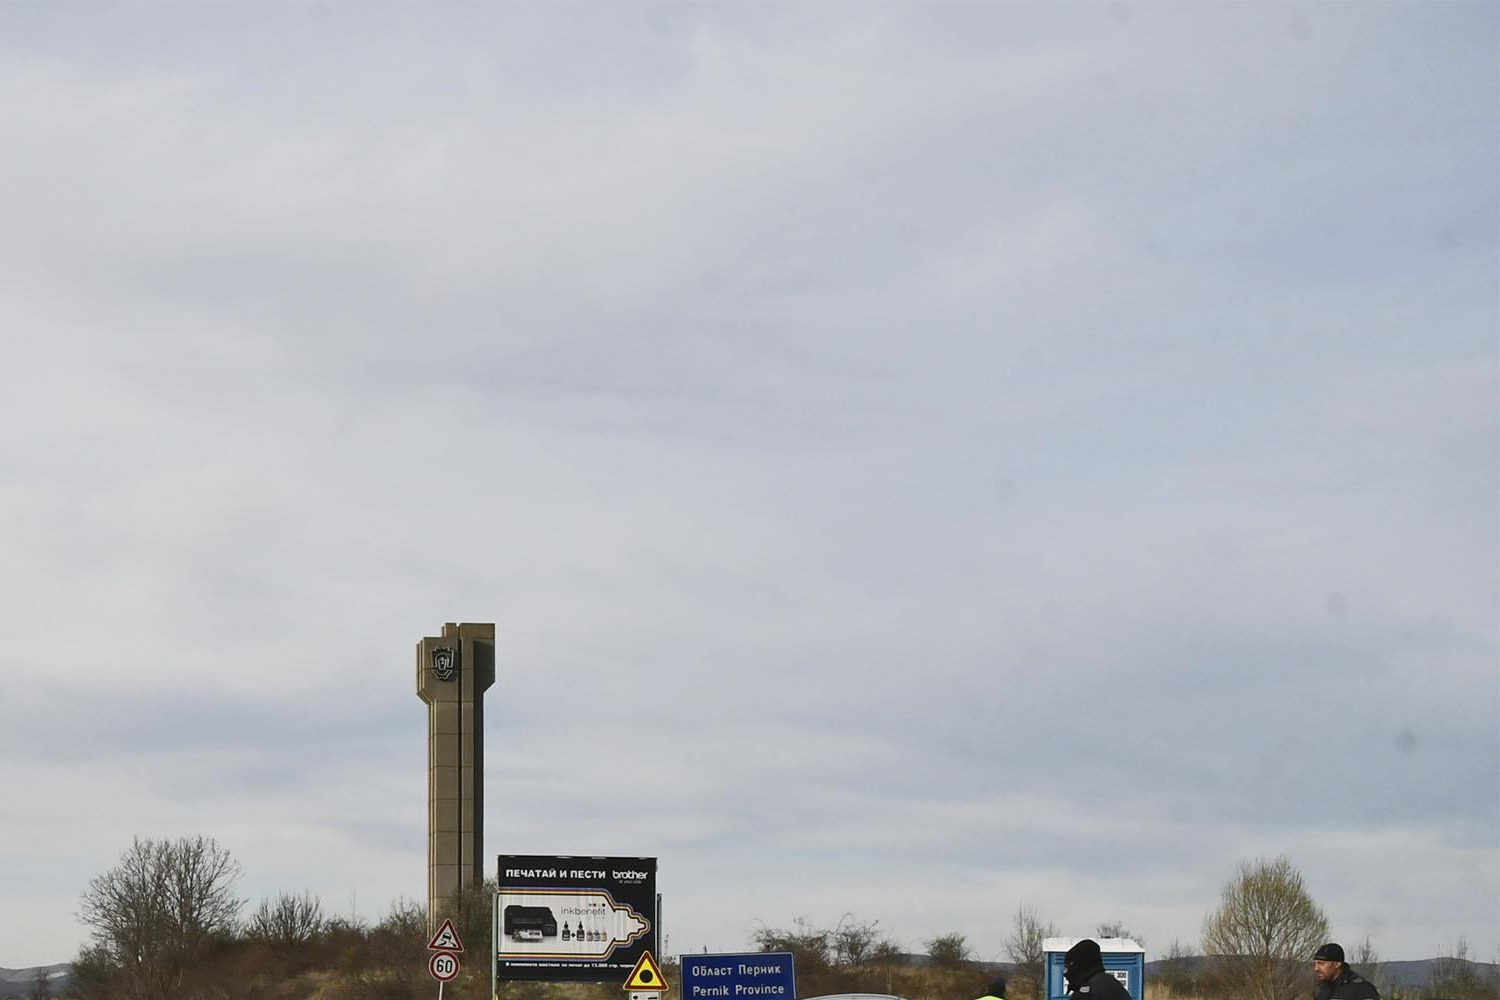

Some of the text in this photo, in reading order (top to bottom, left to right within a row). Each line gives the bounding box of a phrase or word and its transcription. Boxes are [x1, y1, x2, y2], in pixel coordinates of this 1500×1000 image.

[505, 868, 606, 879] ПЕЧАТАЙ И ПЕСТИ
[612, 870, 648, 879] brother
[436, 959, 453, 973] 60
[692, 964, 781, 977] Област Перник
[692, 984, 785, 996] Pernik Province
